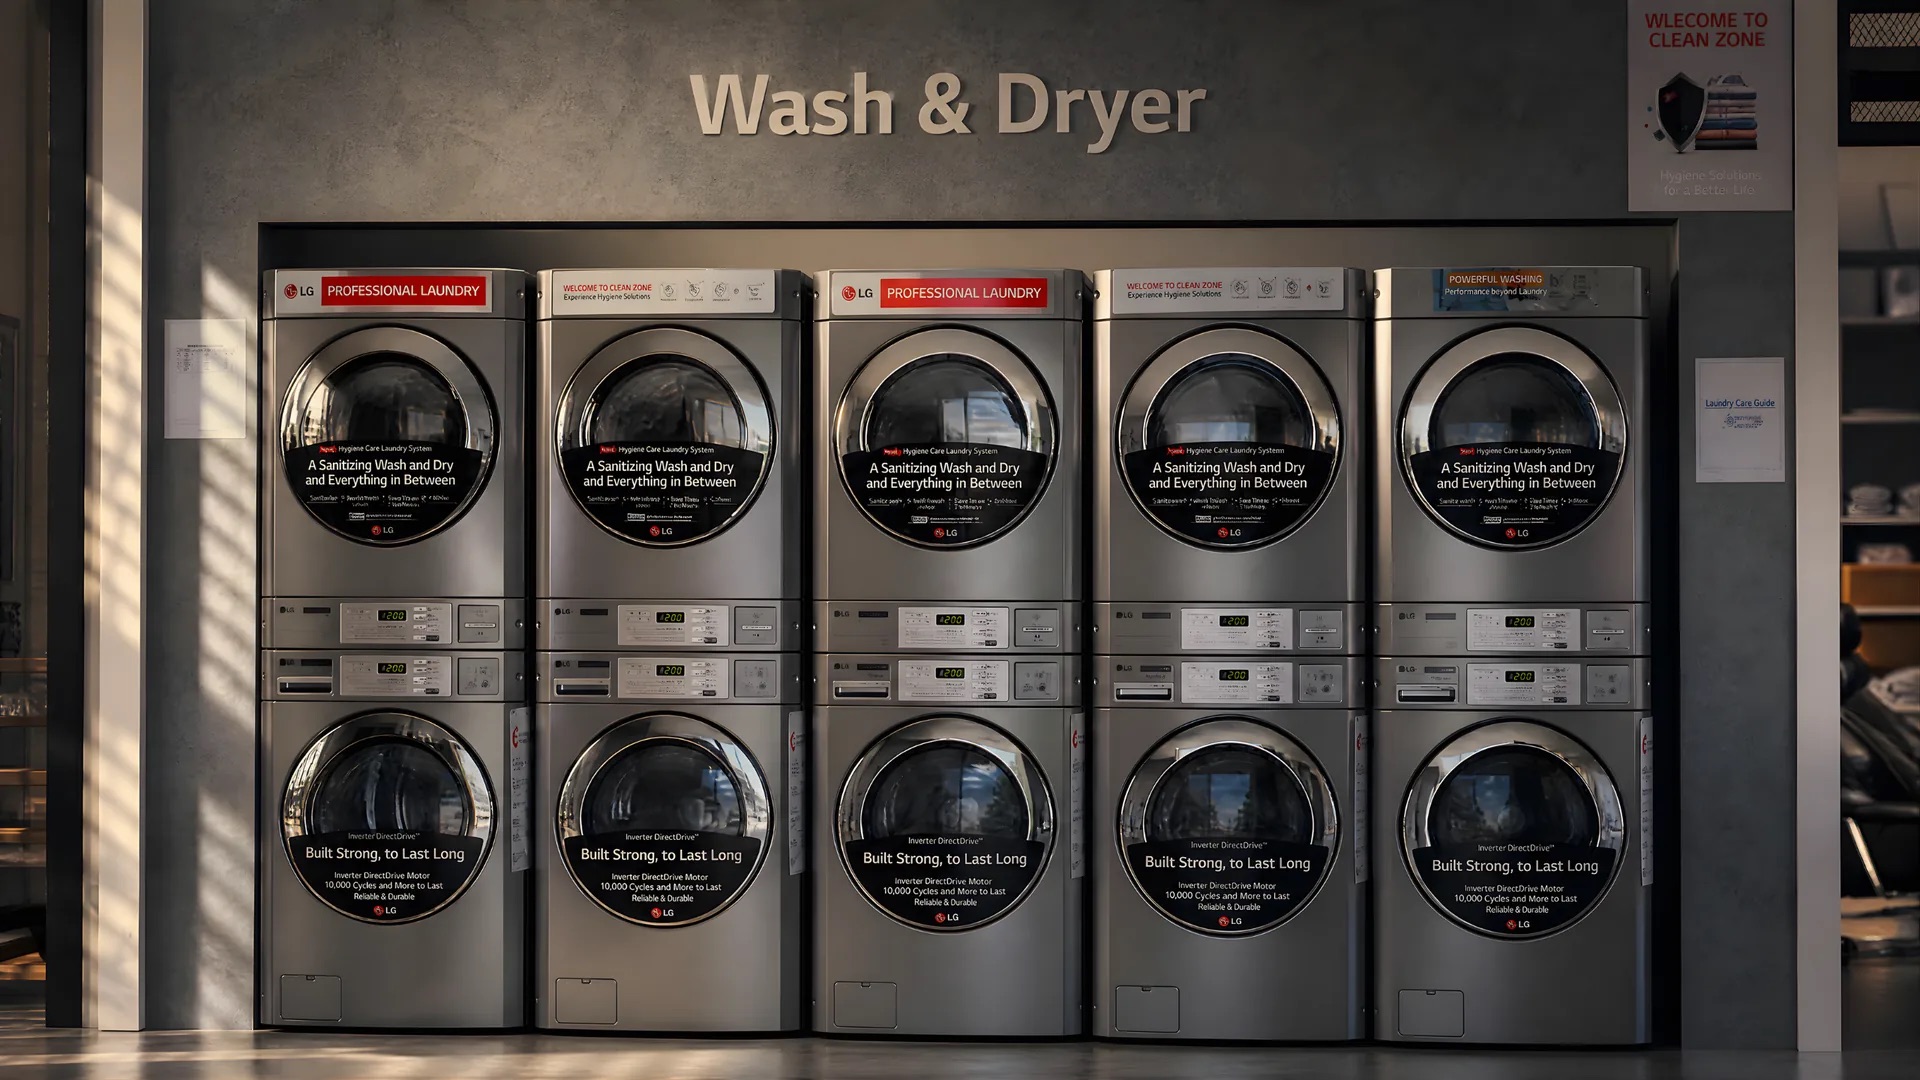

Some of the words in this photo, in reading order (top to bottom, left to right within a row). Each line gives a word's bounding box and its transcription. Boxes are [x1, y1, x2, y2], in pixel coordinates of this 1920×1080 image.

[1645, 13, 1738, 29] WLECOME
[1744, 12, 1768, 28] TO
[1649, 32, 1709, 48] CLEAN
[1715, 32, 1766, 48] ZONE
[689, 71, 893, 136] Wash
[918, 71, 972, 135] &
[998, 71, 1207, 154] Dryer
[1127, 282, 1164, 290] WELCOME
[1165, 282, 1176, 290] TO
[1176, 281, 1201, 290] CLEAN
[1202, 281, 1223, 289] ZONE
[1450, 275, 1498, 284] POWERFUL
[1500, 275, 1542, 283] WASHING
[300, 286, 314, 297] LG
[328, 285, 417, 296] PROFESSIONAL
[421, 285, 480, 296] LAUNDRY
[563, 284, 598, 292] WELCOME
[599, 284, 609, 292] TO
[609, 284, 631, 292] CLEAN
[632, 283, 652, 292] ZONE
[858, 288, 873, 298] LG
[888, 287, 979, 298] PROFESSIONAL
[984, 288, 1042, 298] LAUNDRY
[1445, 288, 1490, 296] Performance
[1491, 288, 1517, 297] beyond
[1519, 288, 1547, 296] Laundry
[597, 293, 622, 302] Hygiene
[1128, 292, 1163, 300] Experience
[1164, 291, 1190, 300] Hygiene
[1705, 399, 1734, 410] Laundry
[1735, 399, 1752, 408] Care
[1753, 399, 1775, 408] Guide
[903, 448, 929, 456] Hygiene
[946, 448, 972, 456] Laundry
[974, 447, 998, 456] System
[1476, 447, 1502, 455] Hygiene
[1520, 447, 1546, 455] Laundry
[1547, 447, 1572, 455] System
[308, 460, 316, 470] A
[319, 459, 372, 473] Sanitizing
[374, 459, 406, 470] Wash
[409, 459, 430, 470] and
[434, 460, 454, 473] Dry
[586, 460, 595, 471] A
[598, 460, 652, 474] Sanitizing
[655, 460, 687, 472] Wash
[690, 460, 710, 472] and
[714, 461, 734, 475] Dry
[870, 462, 878, 474] A
[882, 462, 936, 476] Sanitizing
[940, 462, 972, 473] Wash
[975, 462, 996, 473] and
[1000, 462, 1020, 476] Dry
[1153, 462, 1162, 473] A
[1165, 462, 1220, 476] Sanitizing
[1224, 461, 1256, 473] Wash
[1260, 461, 1281, 472] and
[1285, 462, 1305, 476] Dry
[1441, 462, 1450, 474] A
[1454, 462, 1510, 476] Sanitizing
[1514, 461, 1546, 473] Wash
[1550, 462, 1570, 473] and
[1574, 462, 1594, 476] Dry
[306, 474, 325, 485] and
[328, 474, 387, 488] Everything
[391, 474, 400, 485] in
[404, 474, 455, 485] Between
[584, 475, 603, 486] and
[607, 475, 667, 490] Everything
[671, 476, 680, 486] in
[684, 476, 736, 487] Between
[866, 477, 887, 488] and
[891, 476, 952, 492] Everything
[956, 477, 966, 488] in
[970, 477, 1022, 488] Between
[1149, 477, 1170, 488] and
[1174, 476, 1236, 491] Everything
[1240, 477, 1250, 488] in
[1254, 477, 1307, 488] Between
[1437, 477, 1458, 489] and
[1462, 477, 1525, 492] Everything
[1529, 477, 1539, 488] in
[1543, 477, 1596, 488] Between
[383, 526, 394, 534] LG
[1518, 529, 1528, 537] LG
[306, 847, 333, 858] Built
[336, 848, 381, 862] Strong,
[384, 849, 398, 859] to
[402, 848, 430, 859] Last
[434, 848, 464, 862] Long
[582, 848, 610, 860] Built
[613, 848, 658, 864] Strong,
[662, 850, 676, 861] to
[680, 849, 707, 861] Last
[711, 849, 742, 864] Long
[864, 852, 893, 864] Built
[896, 852, 942, 868] Strong,
[946, 854, 960, 864] to
[965, 853, 992, 865] Last
[996, 853, 1026, 868] Long
[1146, 856, 1176, 868] Built
[1179, 856, 1226, 872] Strong,
[1229, 858, 1243, 868] to
[1248, 857, 1275, 869] Last
[1280, 857, 1310, 872] Long
[1433, 859, 1462, 871] Built
[1466, 860, 1513, 875] Strong,
[1517, 861, 1531, 872] to
[1536, 860, 1564, 872] Last
[1568, 860, 1598, 875] Long
[1210, 882, 1252, 890] DirectDrive
[1253, 882, 1276, 890] Motor
[1166, 891, 1193, 900] 10,000
[1195, 892, 1220, 901] Cycles
[1222, 892, 1238, 900] and
[1240, 892, 1260, 900] More
[1274, 892, 1290, 900] Last
[1518, 920, 1530, 928] LG
